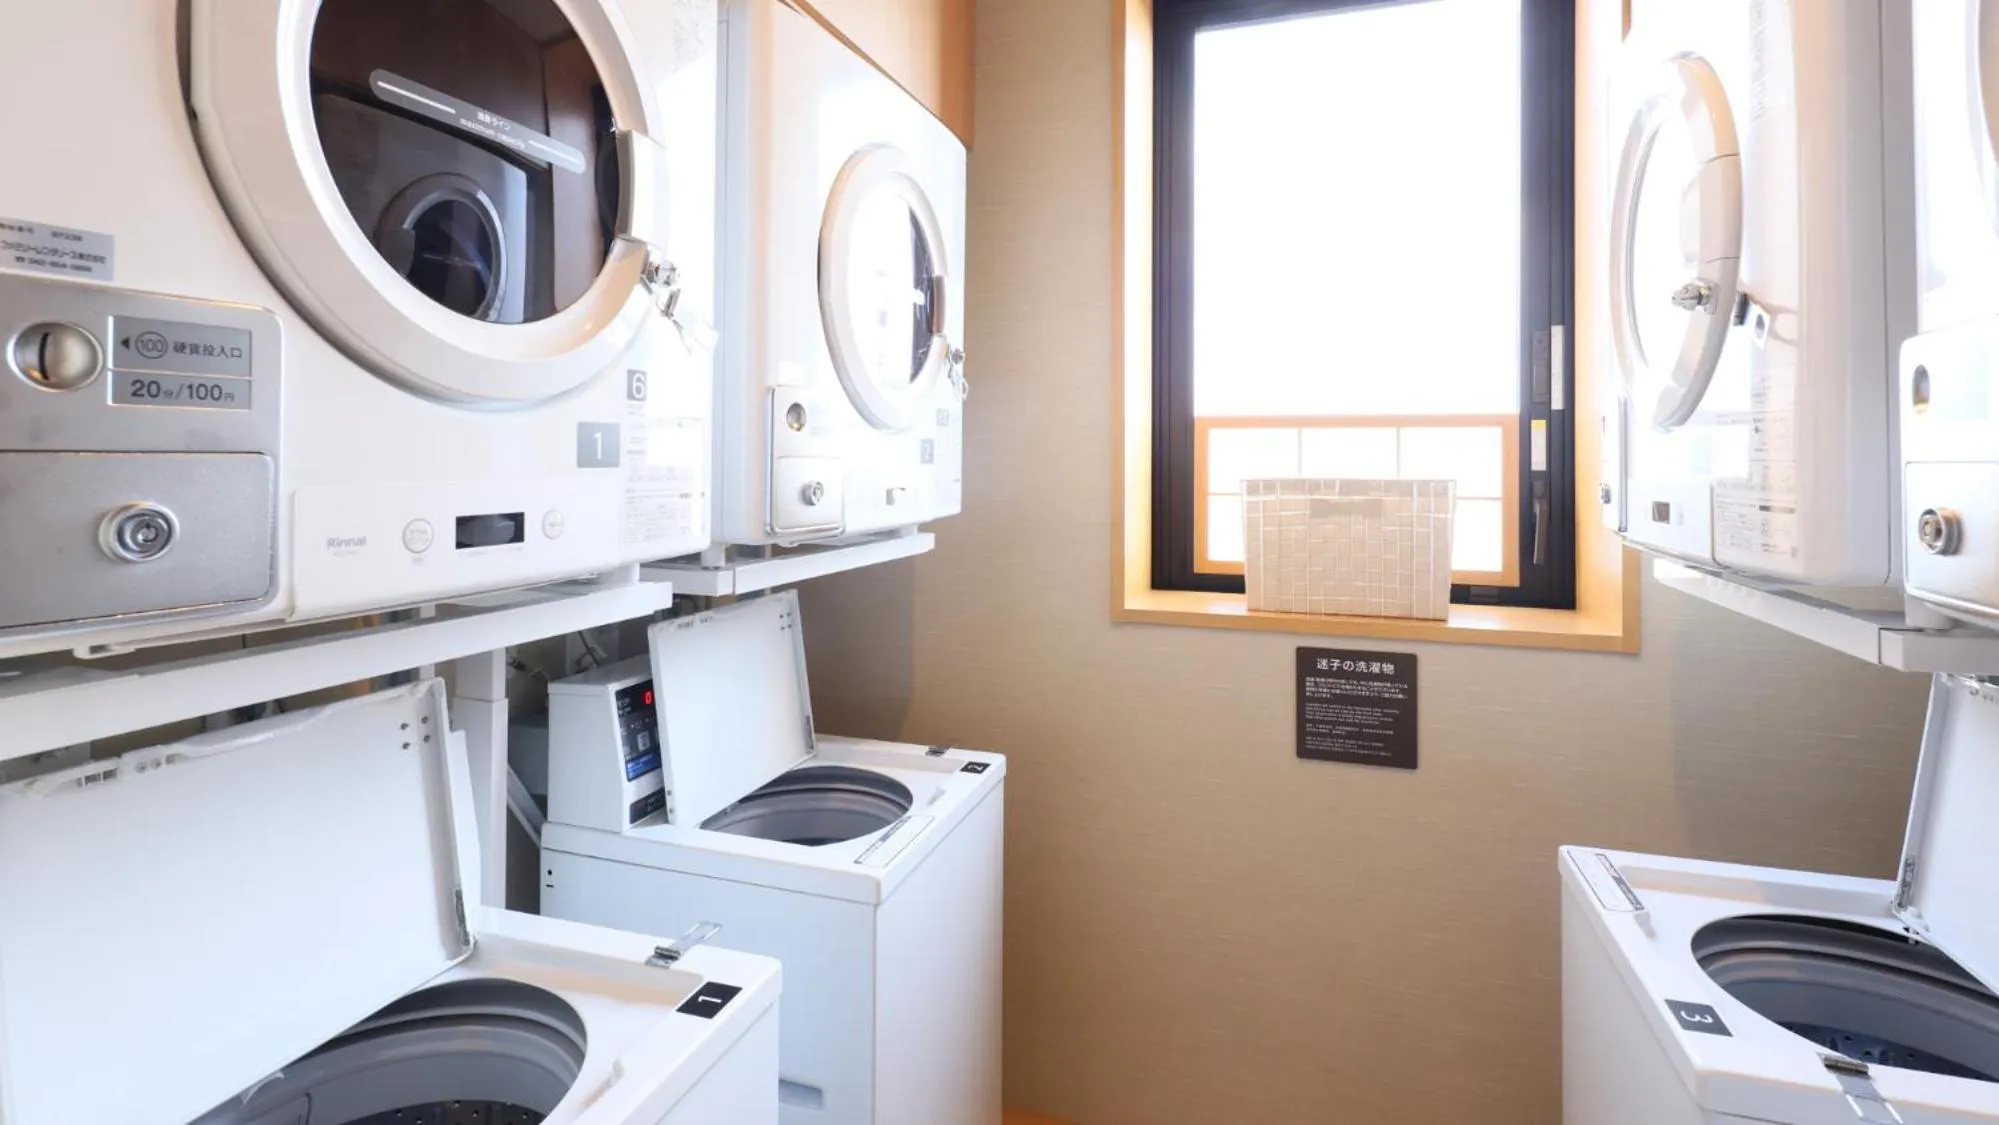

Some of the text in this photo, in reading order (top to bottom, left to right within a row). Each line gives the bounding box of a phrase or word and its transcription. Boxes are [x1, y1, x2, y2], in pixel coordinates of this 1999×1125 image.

[139, 337, 163, 354] 100
[632, 373, 645, 399] 6
[592, 431, 603, 460] 1
[326, 536, 367, 551] Rinnai
[1316, 658, 1396, 675] 迷子の洗濯物
[698, 995, 722, 1003] 1
[1679, 1009, 1714, 1024] 3
